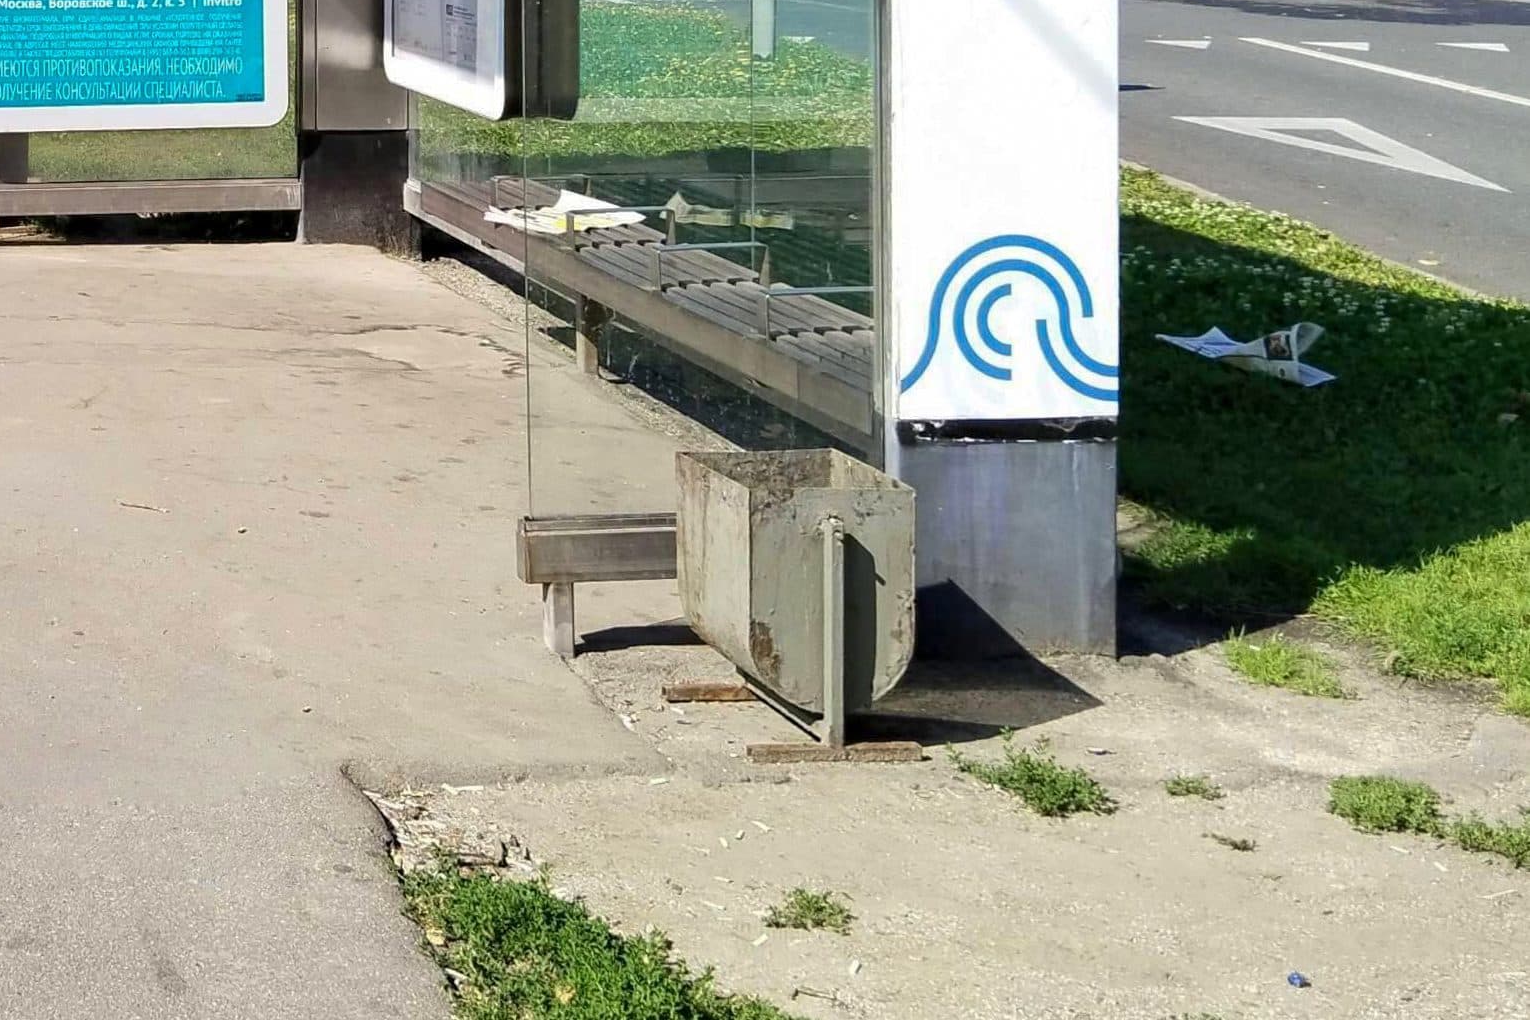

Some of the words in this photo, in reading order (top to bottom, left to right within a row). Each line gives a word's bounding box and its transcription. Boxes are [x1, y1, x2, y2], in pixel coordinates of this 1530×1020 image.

[43, 57, 163, 78] ПРОТИВОПОКАЗАНИЯ.
[166, 55, 243, 78] НЕОБХОДИМО
[55, 81, 141, 101] КОНСУЛЬТАЦИИ
[144, 79, 227, 100] СПЕЦИАЛИСТА.
